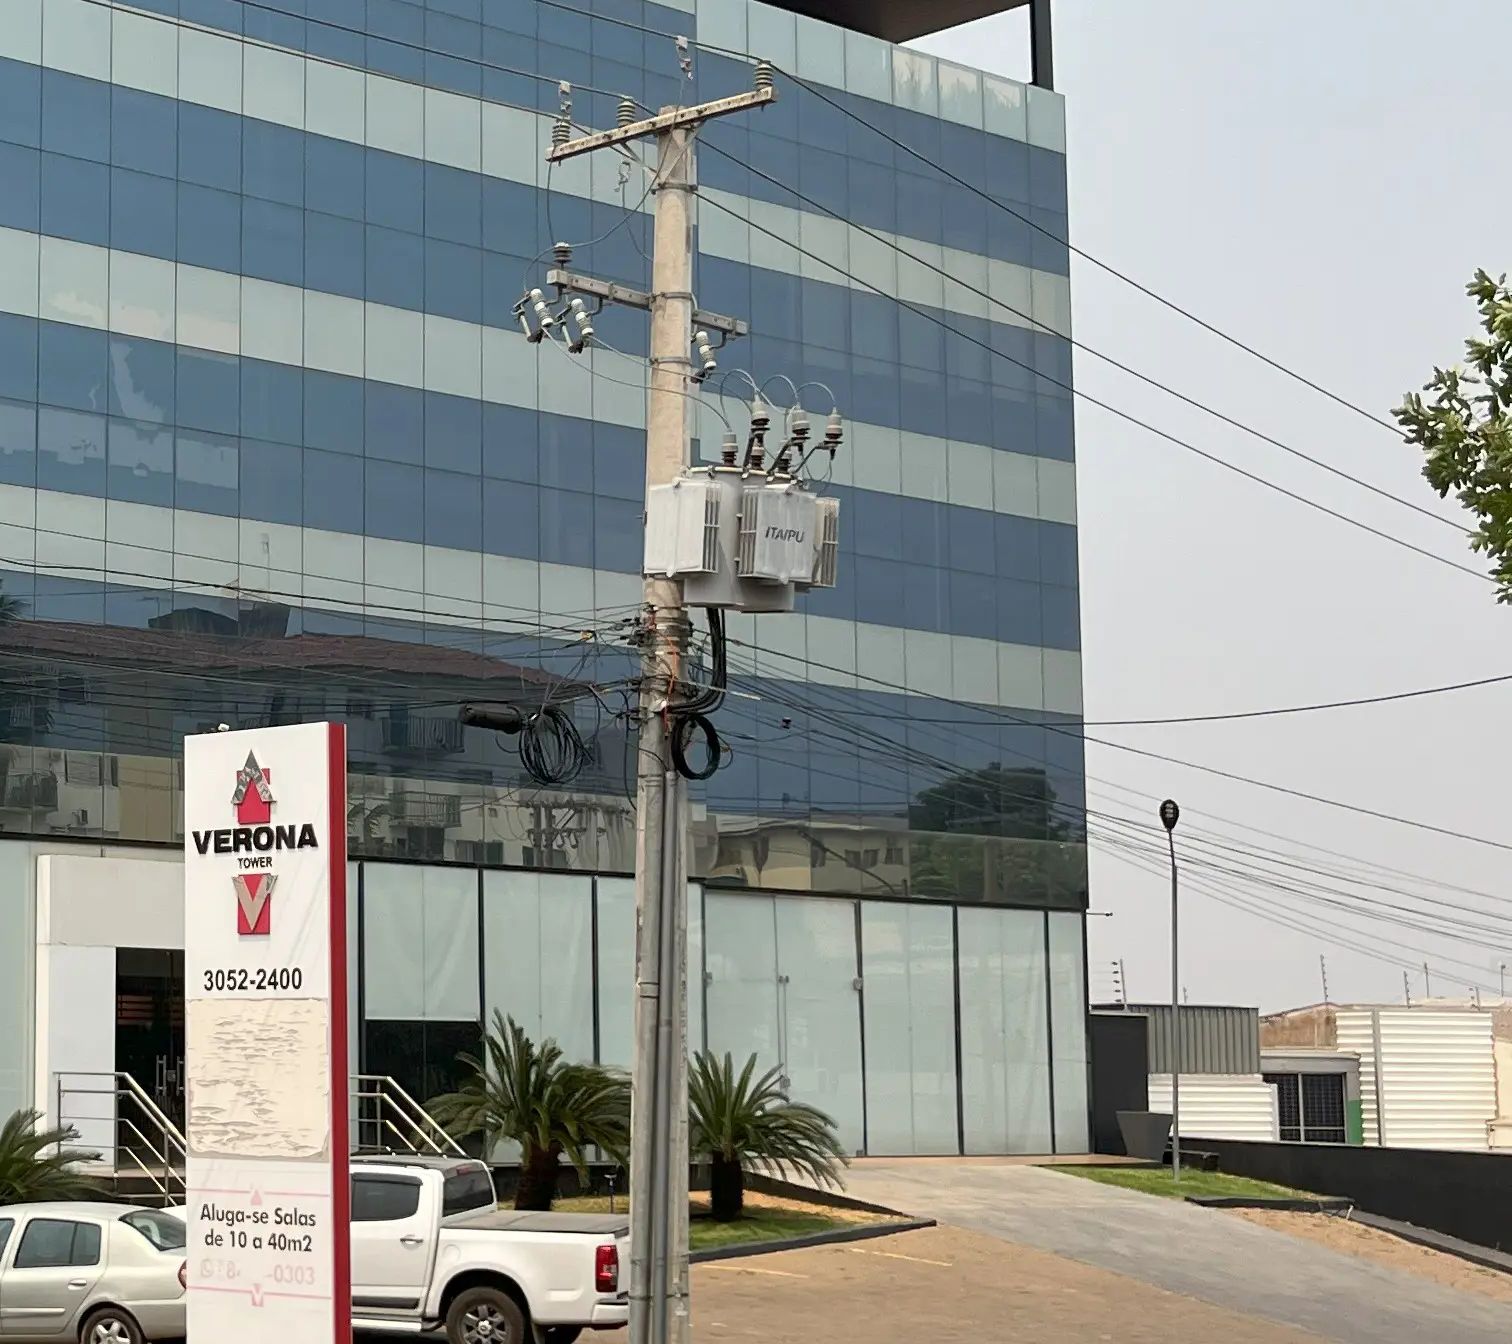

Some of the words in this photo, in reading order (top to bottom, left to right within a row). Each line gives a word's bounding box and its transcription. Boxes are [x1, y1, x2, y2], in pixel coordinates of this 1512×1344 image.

[765, 526, 806, 544] ITAIPU
[191, 823, 319, 855] VERONA
[237, 856, 273, 869] TOWER
[203, 966, 303, 991] 3052-2400
[200, 1203, 269, 1227] Aluga-se
[274, 1207, 317, 1227] Salas
[204, 1228, 224, 1247] de
[229, 1230, 248, 1248] 10
[252, 1237, 263, 1249] a
[267, 1232, 312, 1252] 40m2
